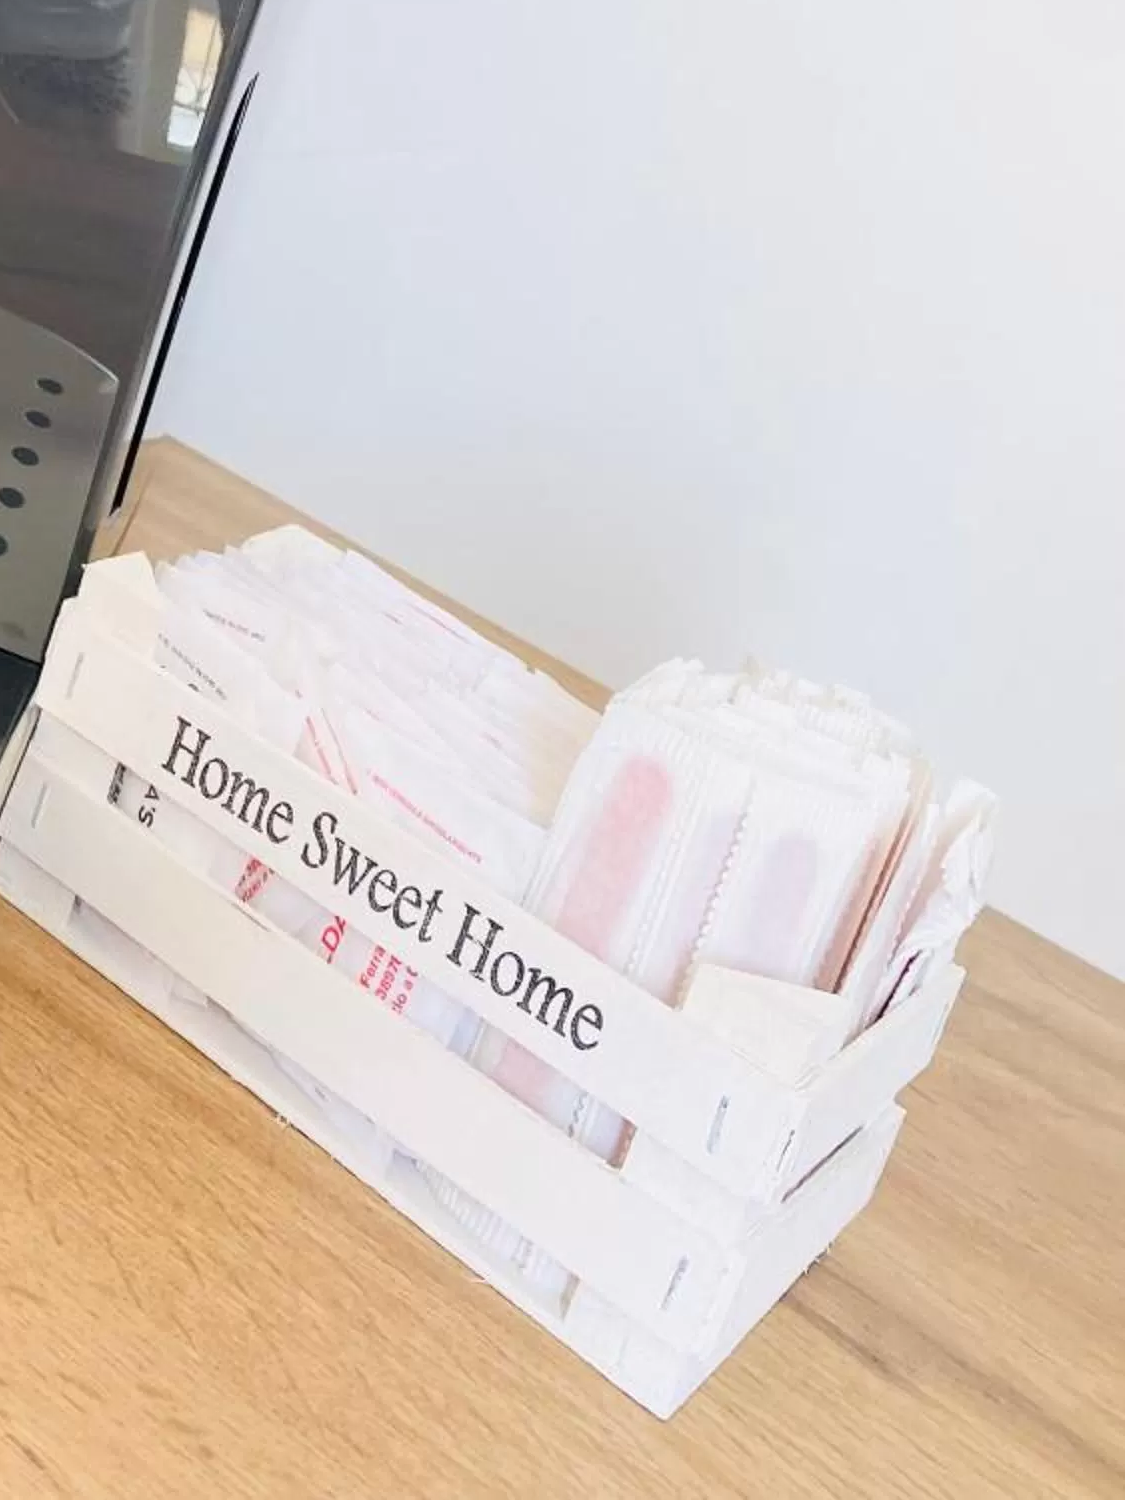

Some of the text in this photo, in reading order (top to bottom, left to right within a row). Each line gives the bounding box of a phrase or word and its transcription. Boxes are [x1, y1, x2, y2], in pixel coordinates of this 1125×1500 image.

[161, 715, 295, 845] Home
[300, 810, 444, 943] Sweet
[446, 902, 605, 1051] Home
